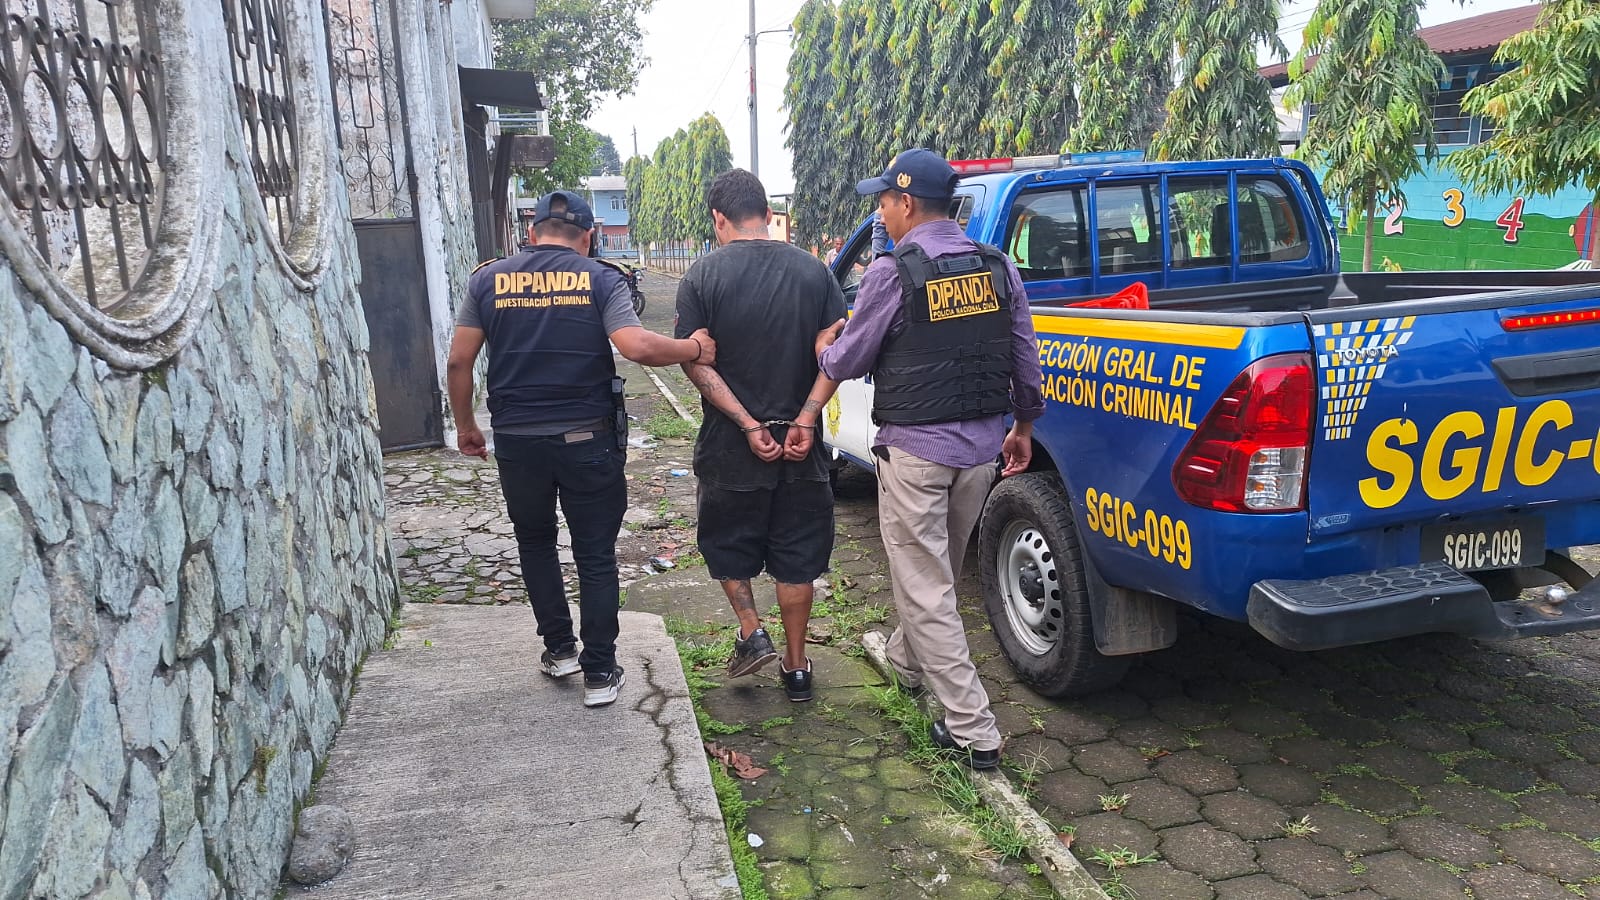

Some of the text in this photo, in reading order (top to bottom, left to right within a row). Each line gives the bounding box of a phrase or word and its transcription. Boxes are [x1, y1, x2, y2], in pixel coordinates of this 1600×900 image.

[1384, 194, 1404, 235] 2
[1443, 188, 1465, 228] 3
[1496, 197, 1525, 243] 4
[495, 271, 592, 295] DIPANDA
[495, 295, 591, 309] INVESTIGACIÓN CRIMINAL
[928, 275, 995, 311] DIPANDA
[1037, 337, 1207, 390] ECCIÓN GRAL. DE
[1334, 344, 1399, 361] TOYOTA
[1101, 382, 1197, 431] CRIMINAL
[1358, 399, 1600, 509] SGIC-
[1085, 487, 1192, 570] SGIC-099
[1443, 528, 1522, 570] SGIC-099
